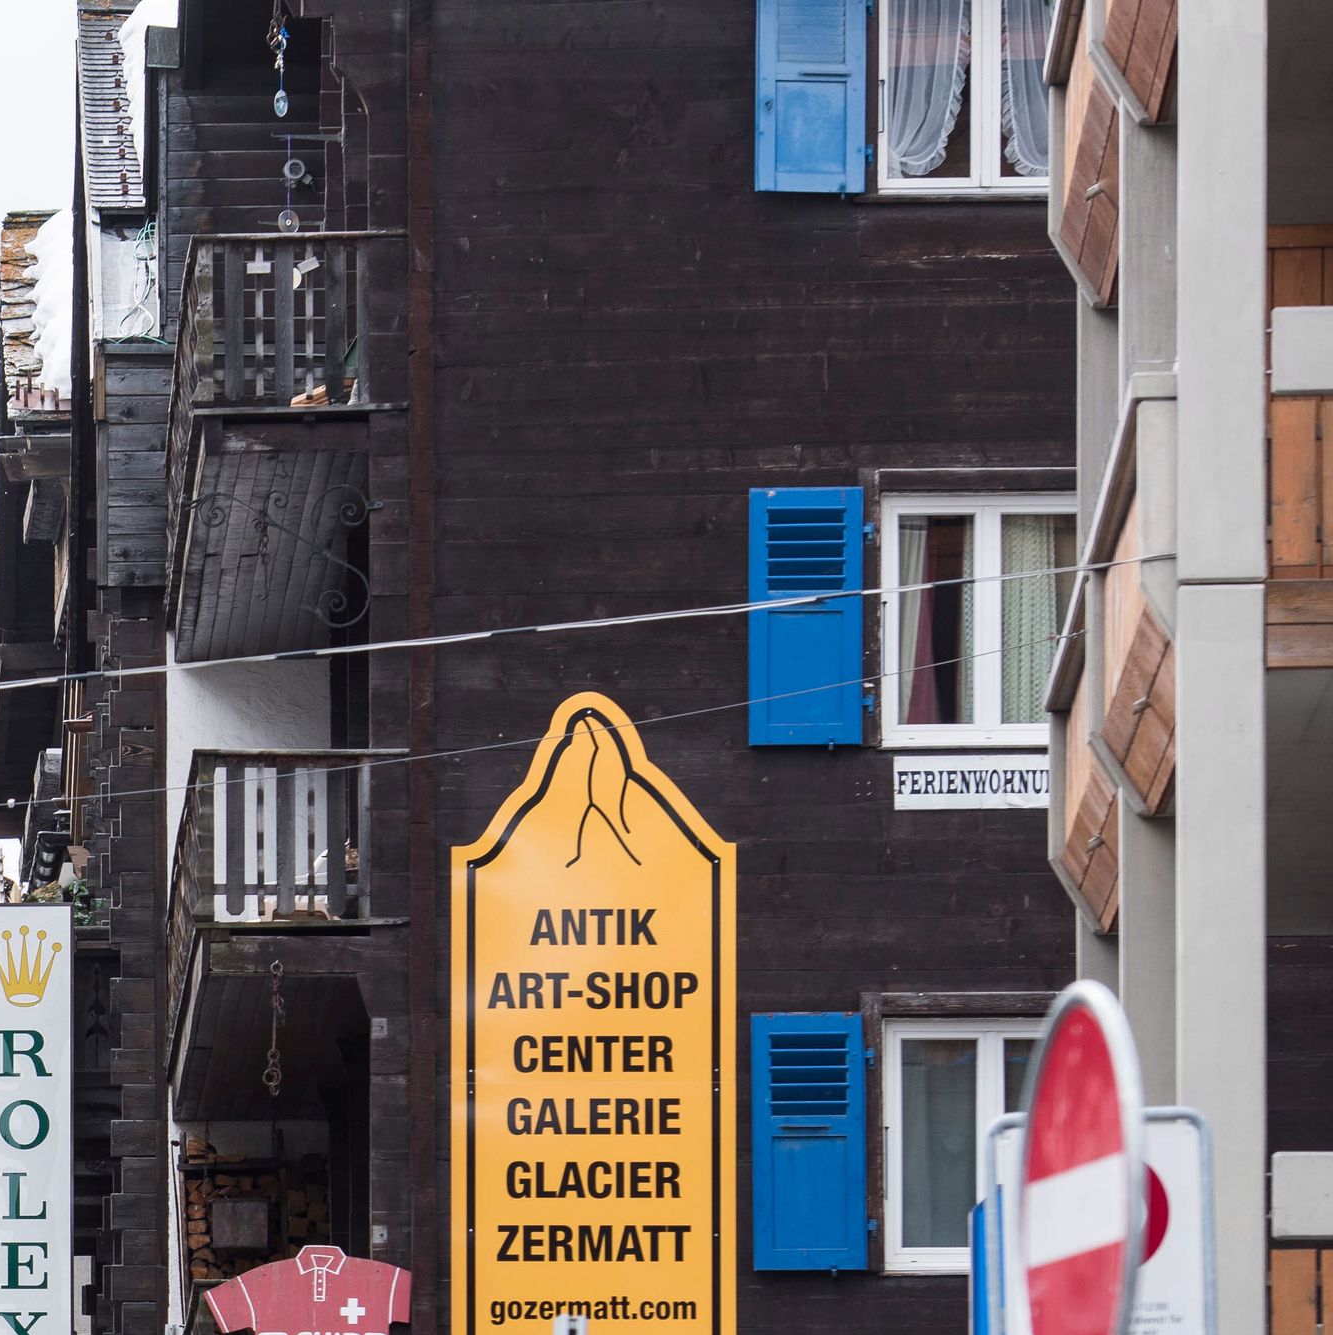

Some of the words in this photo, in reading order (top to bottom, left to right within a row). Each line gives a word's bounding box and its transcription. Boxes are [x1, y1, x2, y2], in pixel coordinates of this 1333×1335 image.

[530, 908, 657, 945] ANTIK
[488, 972, 699, 1010] ART-SHOP
[513, 1035, 674, 1073] CENTER
[507, 1097, 681, 1136] GALERIE
[506, 1161, 681, 1199] GLACIER
[496, 1225, 691, 1263] ZERMATT
[490, 1296, 697, 1326] gozermatt.com
